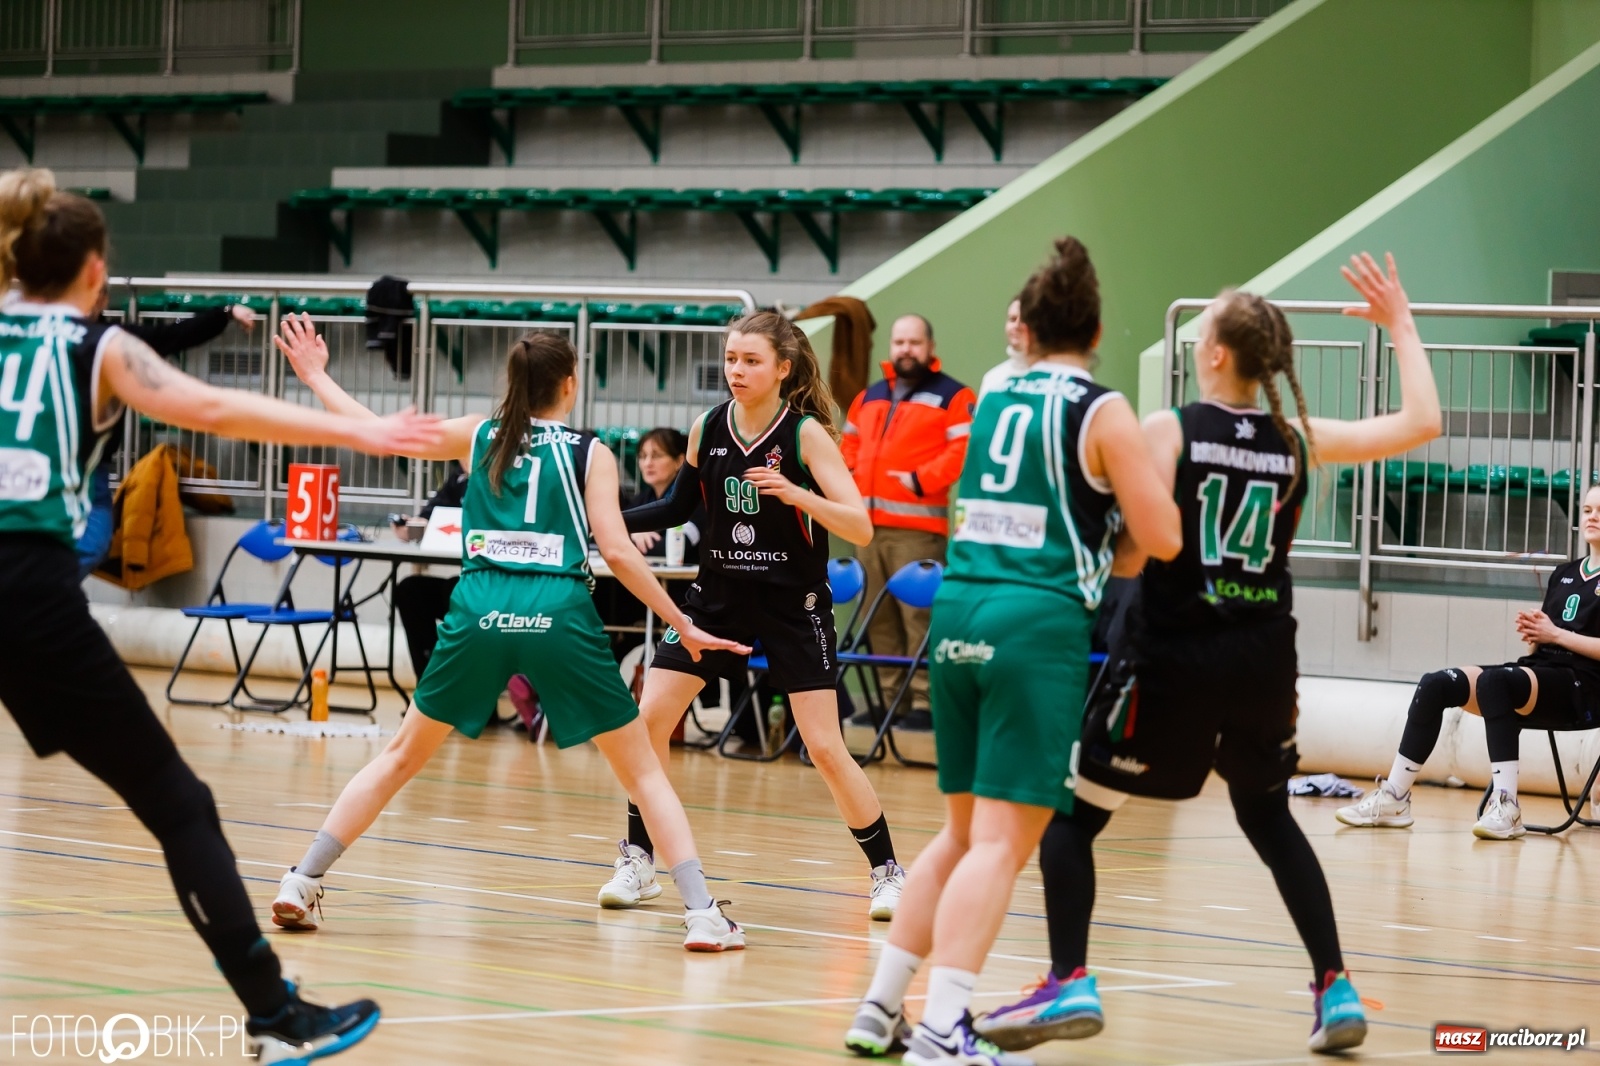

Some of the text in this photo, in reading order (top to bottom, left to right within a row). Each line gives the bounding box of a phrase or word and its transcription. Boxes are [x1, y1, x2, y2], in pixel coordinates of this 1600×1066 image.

[980, 403, 1033, 493] 9
[291, 472, 315, 523] 5
[322, 473, 338, 524] 5
[724, 476, 760, 515] 99
[1197, 472, 1279, 574] 14
[486, 545, 558, 559] WAGTECH
[722, 563, 769, 572] Connecting Europe
[728, 550, 788, 562] LOGISTICS
[496, 612, 553, 629] Clavis
[1562, 594, 1581, 621] 9
